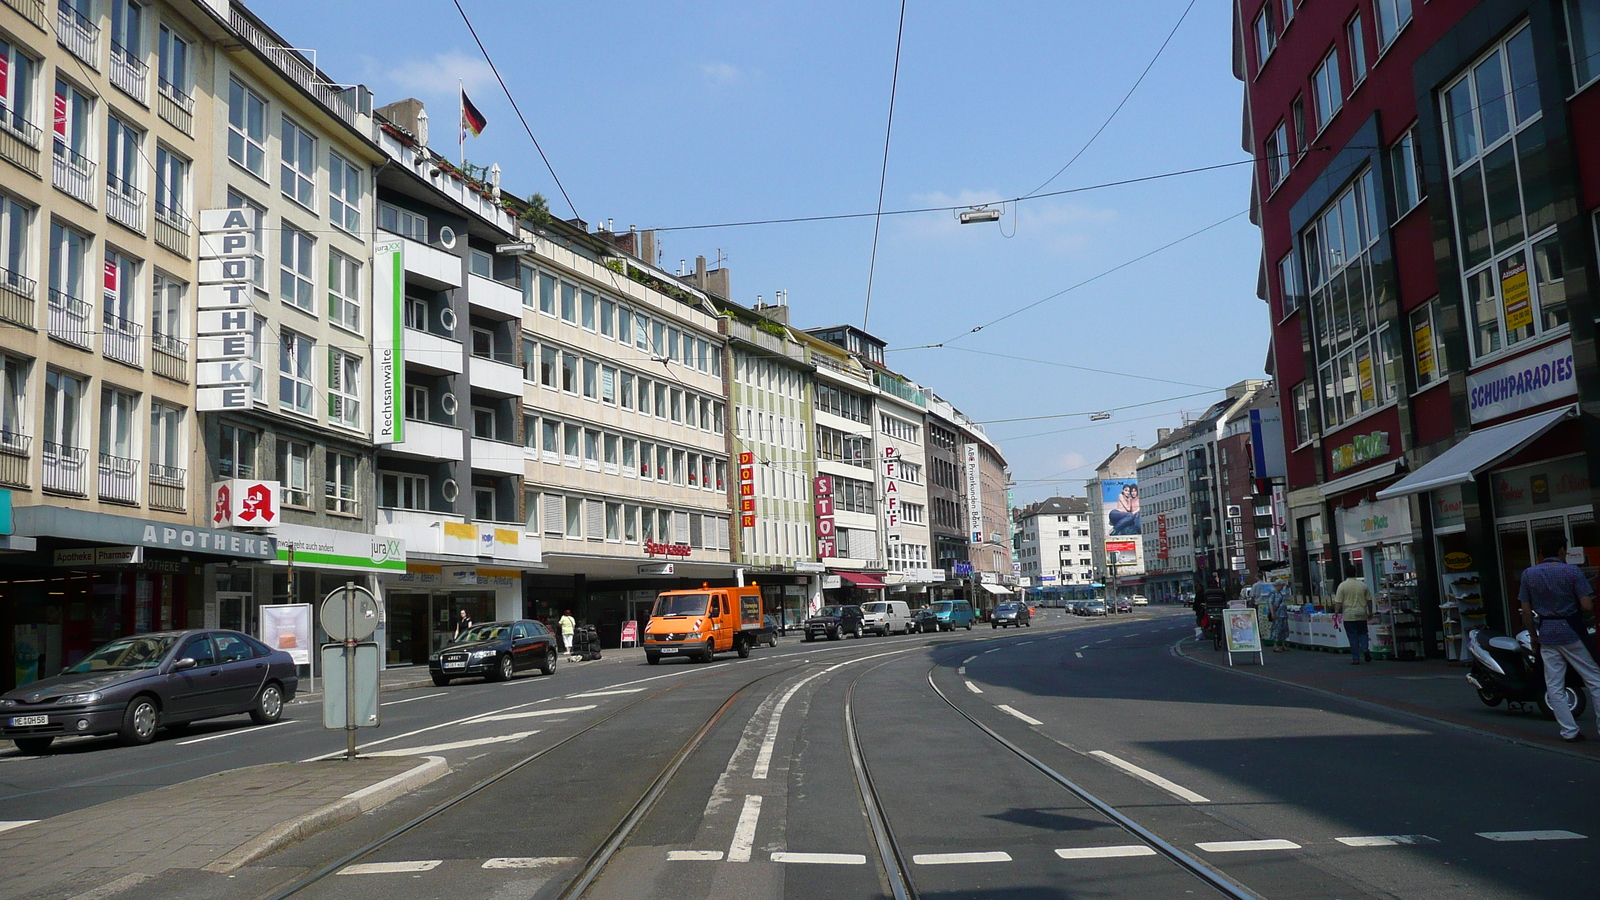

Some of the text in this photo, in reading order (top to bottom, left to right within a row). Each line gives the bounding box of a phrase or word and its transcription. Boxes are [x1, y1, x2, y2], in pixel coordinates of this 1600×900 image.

[222, 210, 249, 408] APOTHEKE
[382, 349, 392, 437] Rechtsanwälte
[1471, 355, 1573, 410] SCHUHPARADIES
[742, 453, 752, 527] DÖNER
[885, 447, 898, 526] PFAFF
[969, 463, 978, 509] Privatkunden
[143, 525, 268, 554] APOTHEKE
[819, 479, 832, 557] STOFF
[972, 511, 980, 529] Bank
[57, 549, 134, 563] Apotheke Pharmacy
[294, 540, 305, 551] geht
[306, 542, 318, 550] auch
[318, 543, 334, 553] anders
[646, 538, 692, 557] Sparkasse
